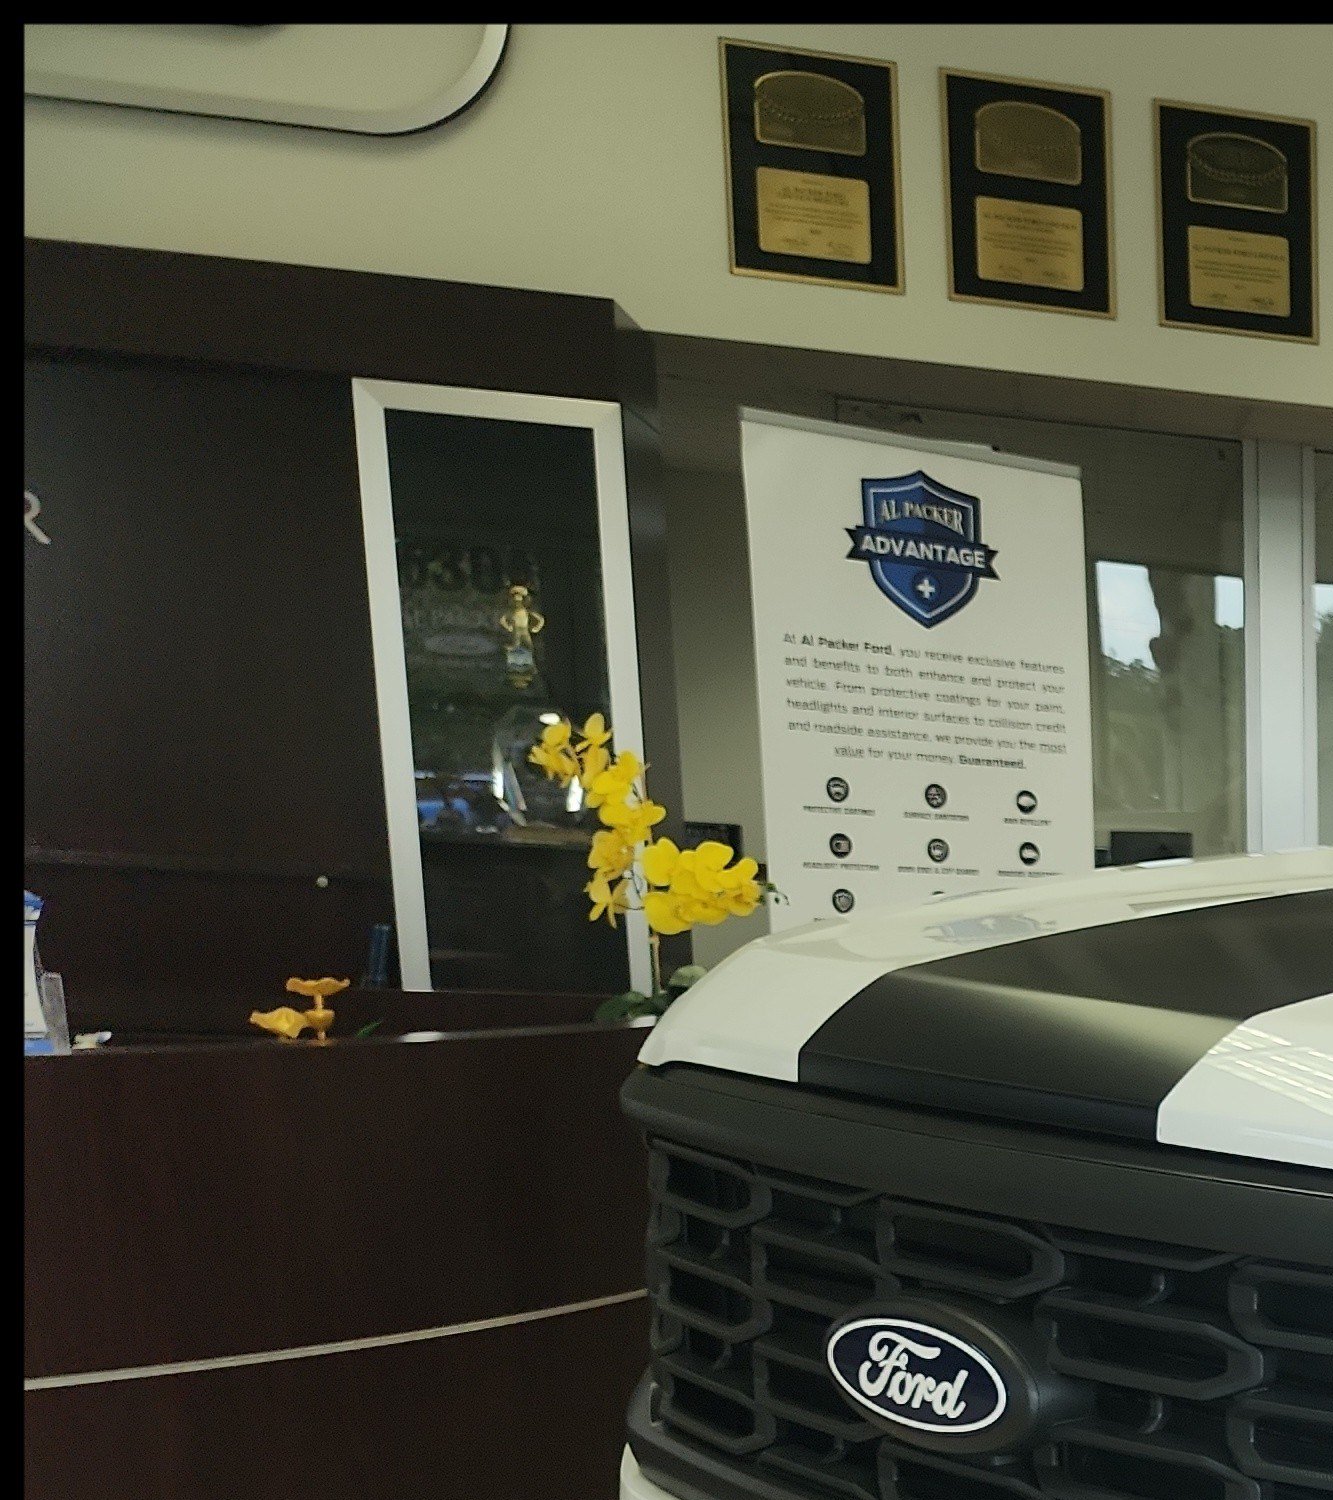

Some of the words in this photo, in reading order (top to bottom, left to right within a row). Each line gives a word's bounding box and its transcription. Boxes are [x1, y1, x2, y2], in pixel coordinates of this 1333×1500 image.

[881, 499, 900, 521] AL
[904, 502, 965, 535] PACKER
[862, 534, 987, 569] ADVANTAGE
[785, 656, 807, 668] and
[813, 658, 861, 674] benefits
[866, 664, 879, 675] to
[885, 665, 913, 678] both
[918, 671, 965, 684] enhance
[971, 675, 992, 687] and
[997, 679, 1036, 692] protect
[925, 651, 963, 663] receive
[967, 655, 1016, 669] exclusive
[1020, 660, 1065, 674] features
[836, 681, 865, 694] From
[871, 687, 930, 700] protective
[936, 693, 981, 708] coatings
[787, 698, 848, 714] headlights
[852, 705, 874, 716] and
[924, 712, 970, 725] surfaces
[788, 721, 811, 733] and
[815, 723, 863, 737] roadside
[955, 736, 993, 748] provide
[1020, 740, 1036, 750] the
[834, 746, 864, 759] value
[868, 747, 884, 759] for
[858, 1330, 969, 1419] Ford
